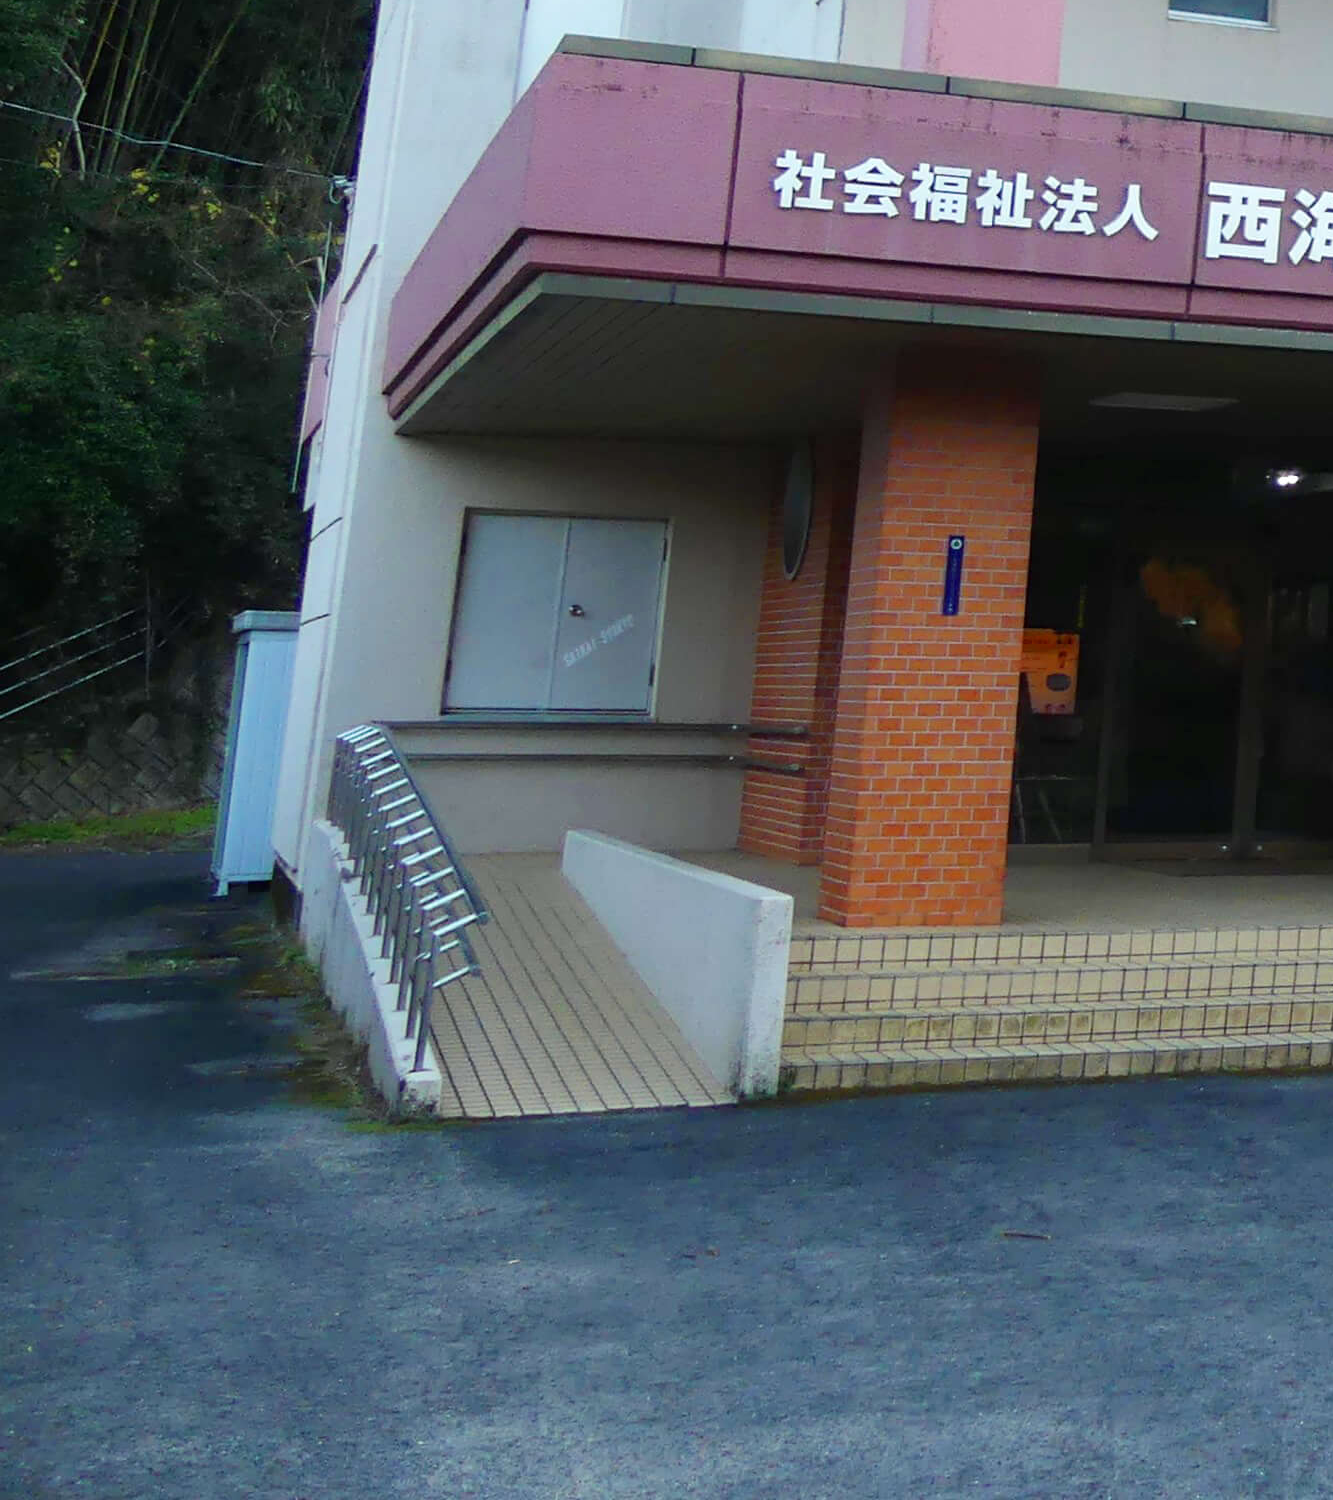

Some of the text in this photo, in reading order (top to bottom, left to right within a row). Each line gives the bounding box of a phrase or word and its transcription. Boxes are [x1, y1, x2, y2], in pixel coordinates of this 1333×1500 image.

[774, 149, 1159, 241] 社会福祉法人
